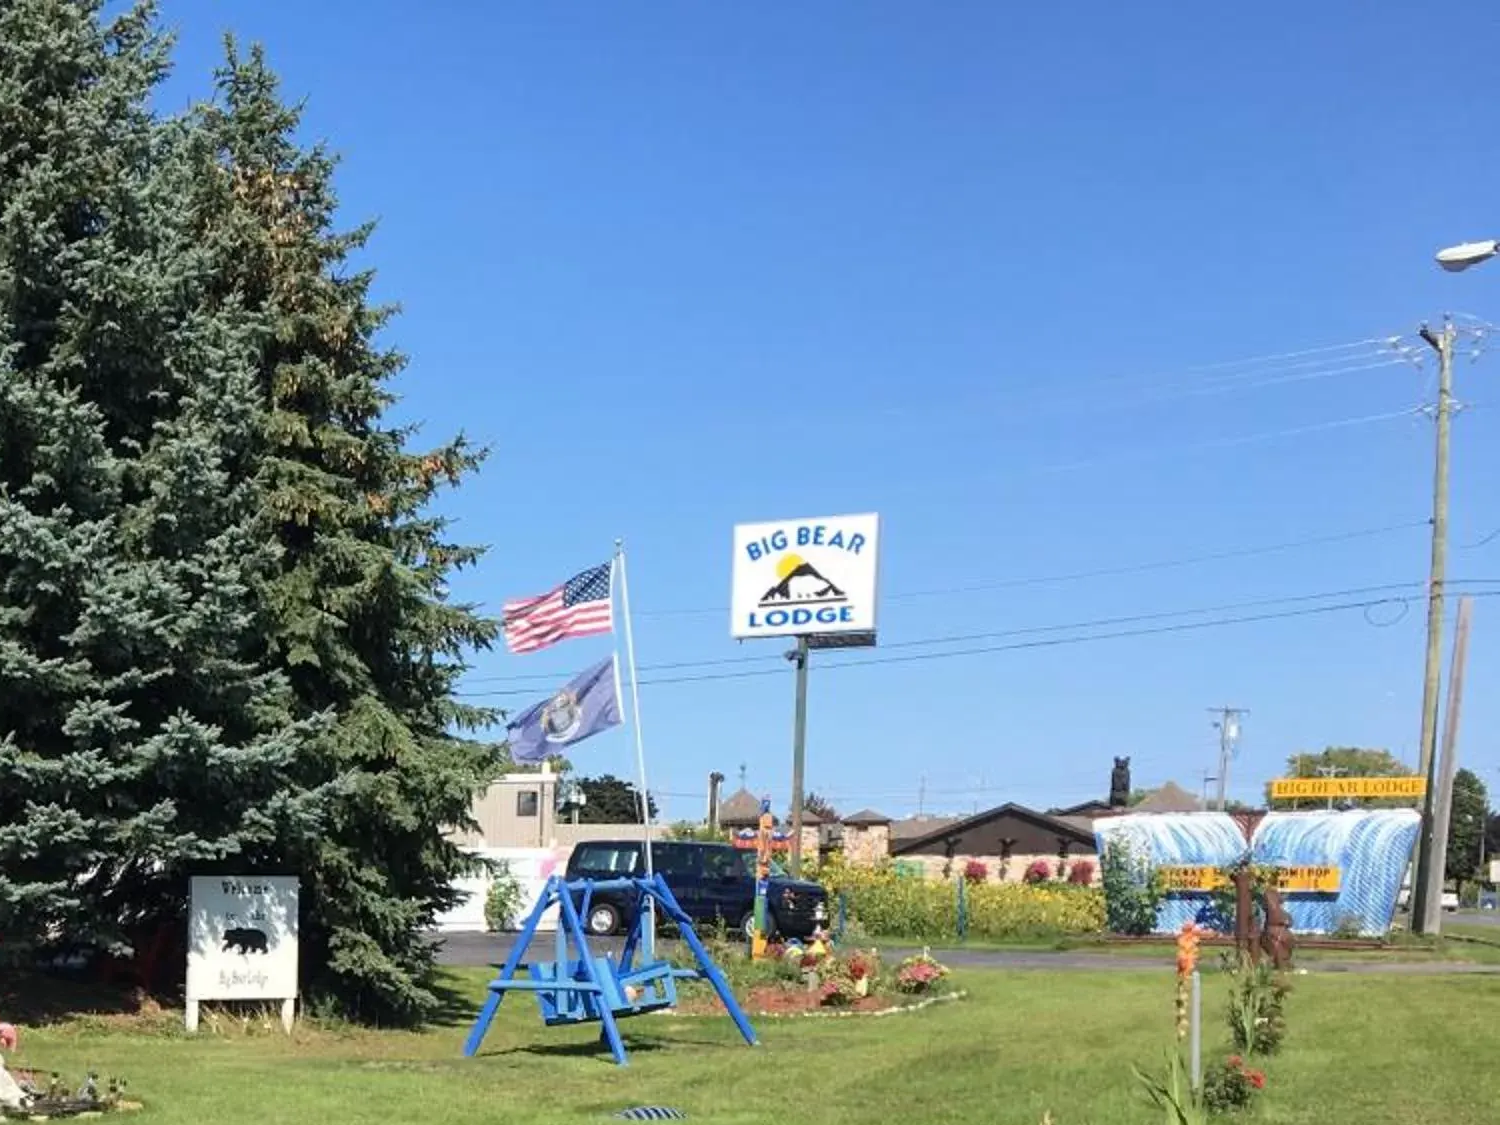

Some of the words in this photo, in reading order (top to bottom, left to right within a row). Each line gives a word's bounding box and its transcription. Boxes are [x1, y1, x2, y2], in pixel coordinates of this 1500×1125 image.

[746, 529, 788, 561] BIG
[797, 525, 865, 555] BEAR
[749, 605, 854, 628] LODGE
[1276, 781, 1306, 794] BIG
[1364, 779, 1420, 792] LODGE
